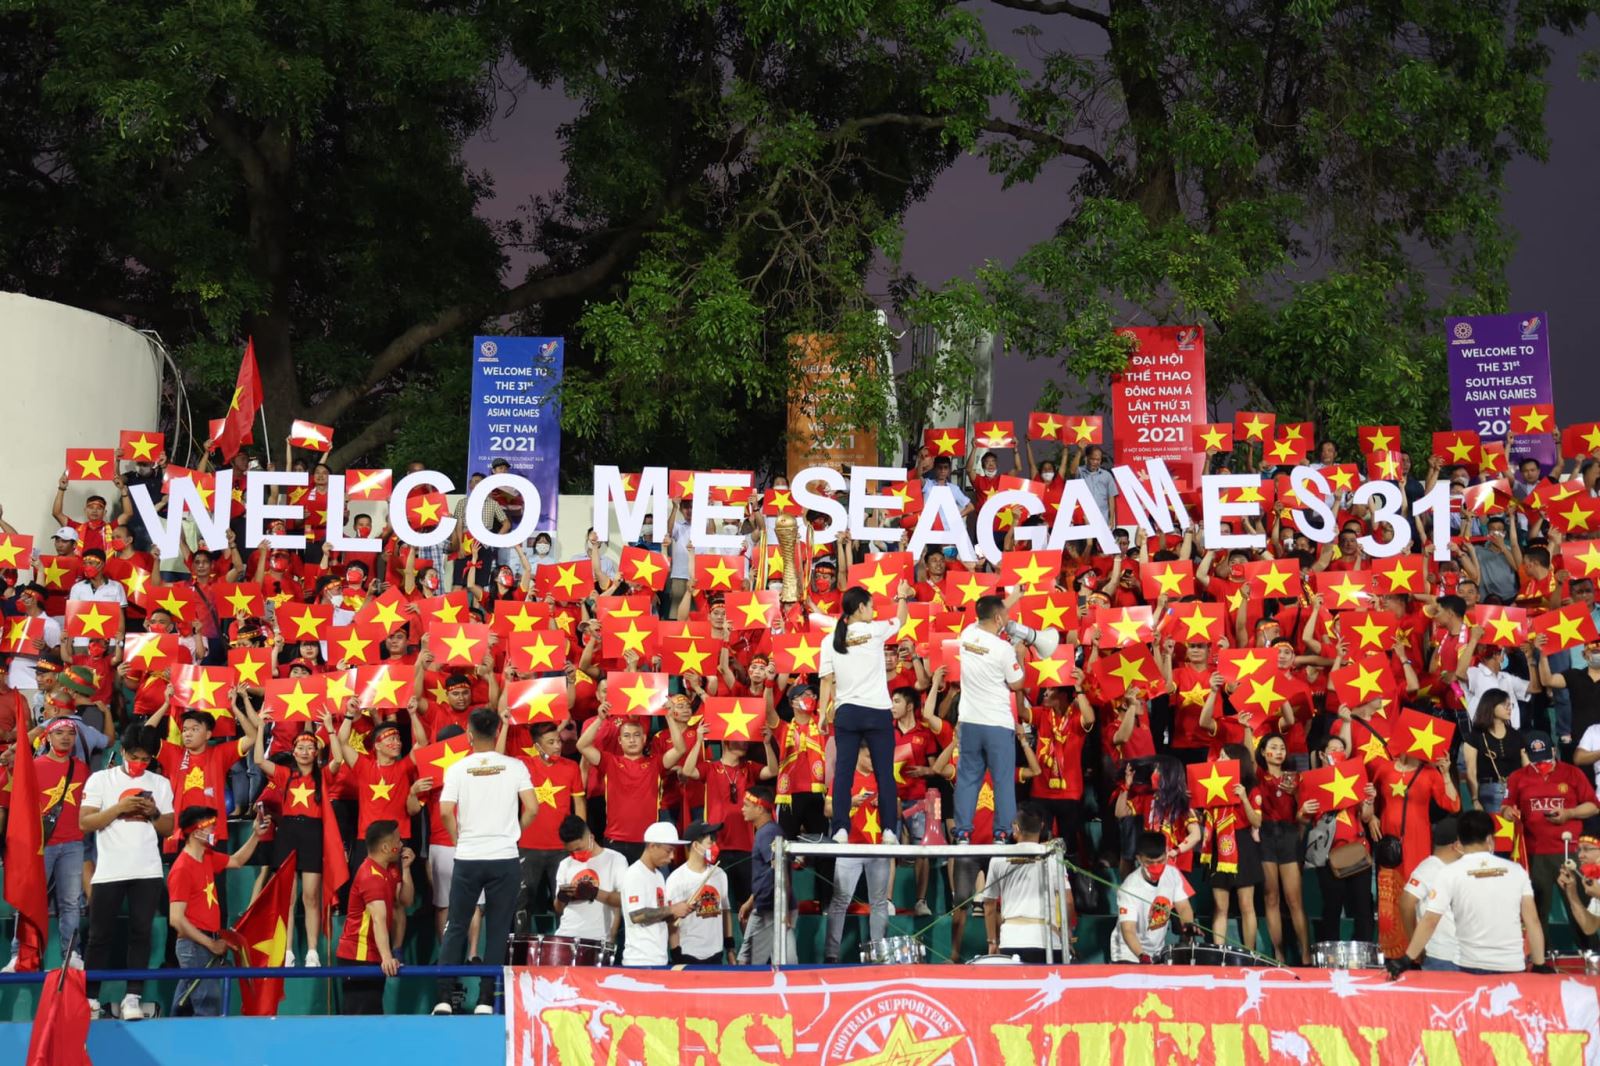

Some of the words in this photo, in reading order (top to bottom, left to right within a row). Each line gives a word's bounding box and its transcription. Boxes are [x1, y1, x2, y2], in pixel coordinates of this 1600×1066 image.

[1461, 347, 1517, 358] WELCOME
[1519, 346, 1534, 355] TO
[1132, 355, 1155, 367] ĐẠI
[1160, 353, 1183, 367] HỘI
[483, 367, 532, 376] WELCOME
[1477, 363, 1500, 372] THE
[1154, 371, 1191, 380] THAO
[496, 381, 515, 390] THE
[1465, 376, 1534, 388] SOUTHEAST
[1125, 385, 1155, 397] ĐÔNG
[1159, 387, 1182, 396] NAM
[1185, 384, 1192, 395] Á
[1465, 390, 1497, 402] ASIAN
[1500, 389, 1537, 399] GAMES
[1154, 400, 1177, 410] THỨ
[1180, 401, 1190, 410] 31
[487, 408, 510, 417] ASIAN
[513, 409, 540, 418] GAMES
[1474, 407, 1500, 416] VIET
[1128, 413, 1157, 426] VIỆT
[1161, 414, 1191, 423] NAM
[489, 424, 511, 433] VIET
[513, 425, 538, 433] NAM
[1137, 427, 1184, 443] 2021
[490, 436, 536, 451] 2021
[1532, 798, 1563, 809] AIG
[831, 1007, 876, 1060] FOOTBALL
[877, 998, 952, 1032] SUPPORTERS
